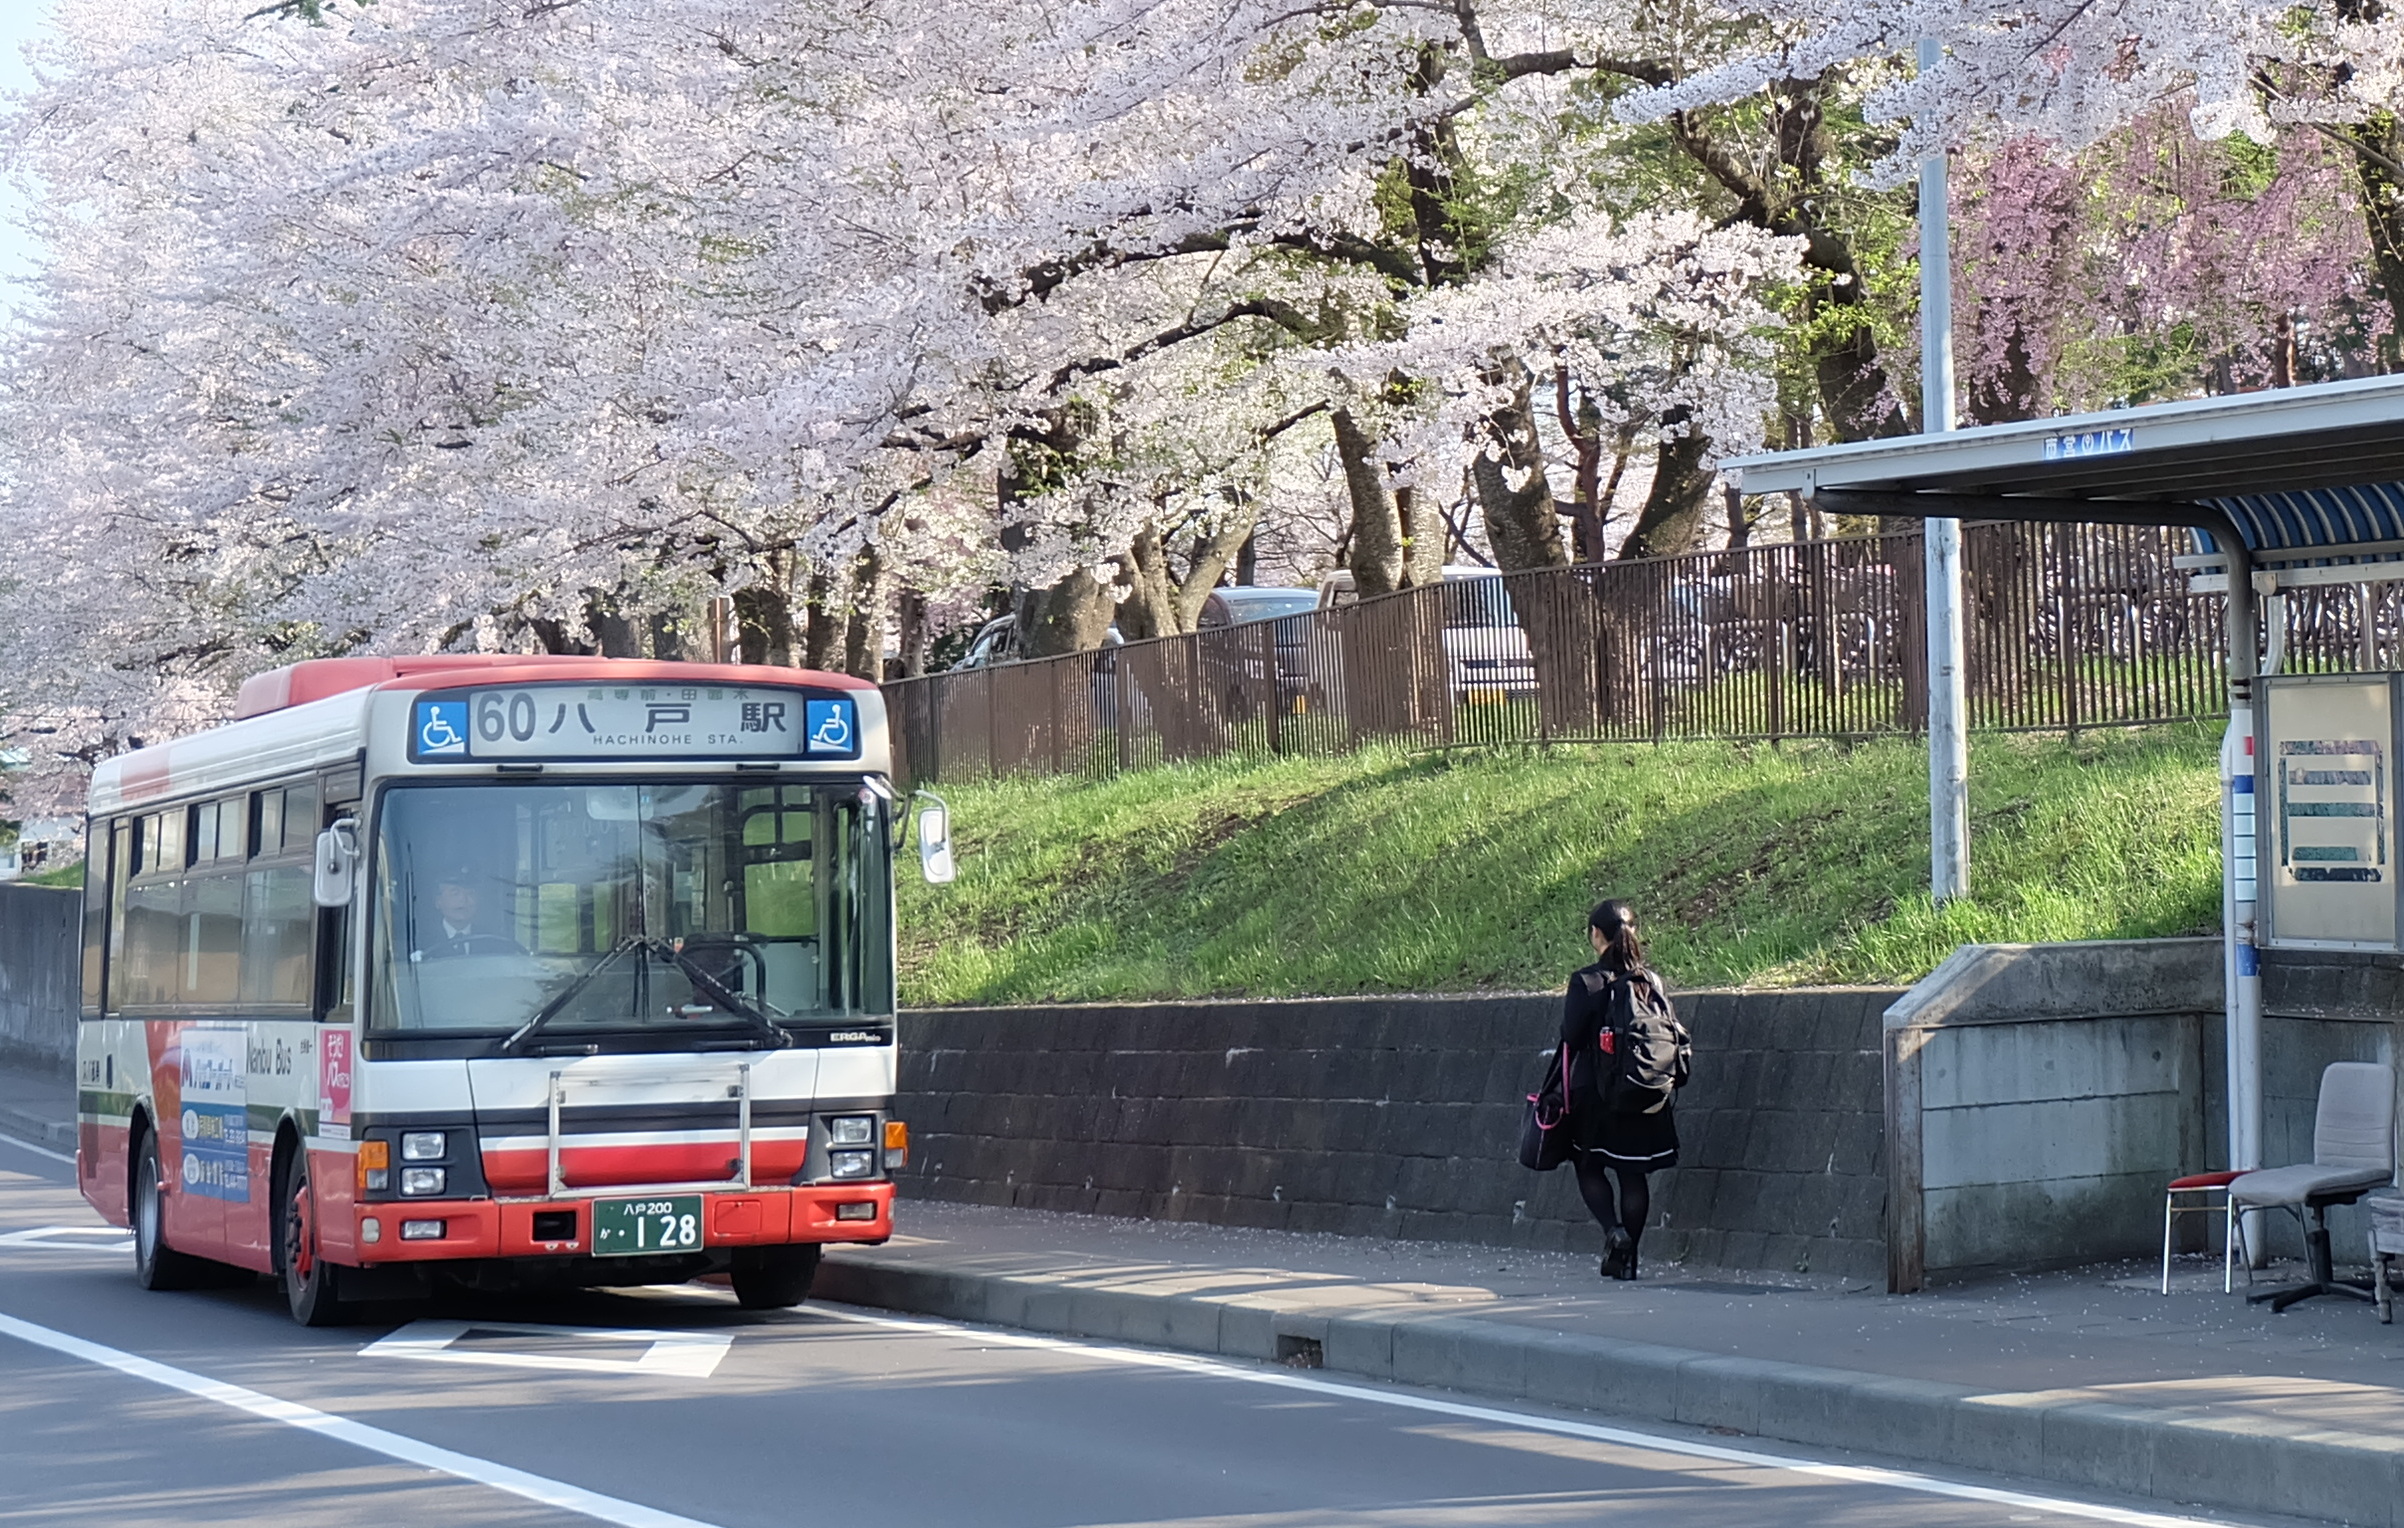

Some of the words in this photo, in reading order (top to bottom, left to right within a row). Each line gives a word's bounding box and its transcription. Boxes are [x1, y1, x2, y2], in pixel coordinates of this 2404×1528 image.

[476, 691, 537, 742] 60
[548, 701, 788, 733] 八戸駅
[593, 734, 692, 745] HACHINOHE
[707, 734, 743, 744] STA.
[246, 1037, 272, 1075] Nanbu
[276, 1038, 292, 1075] Bus
